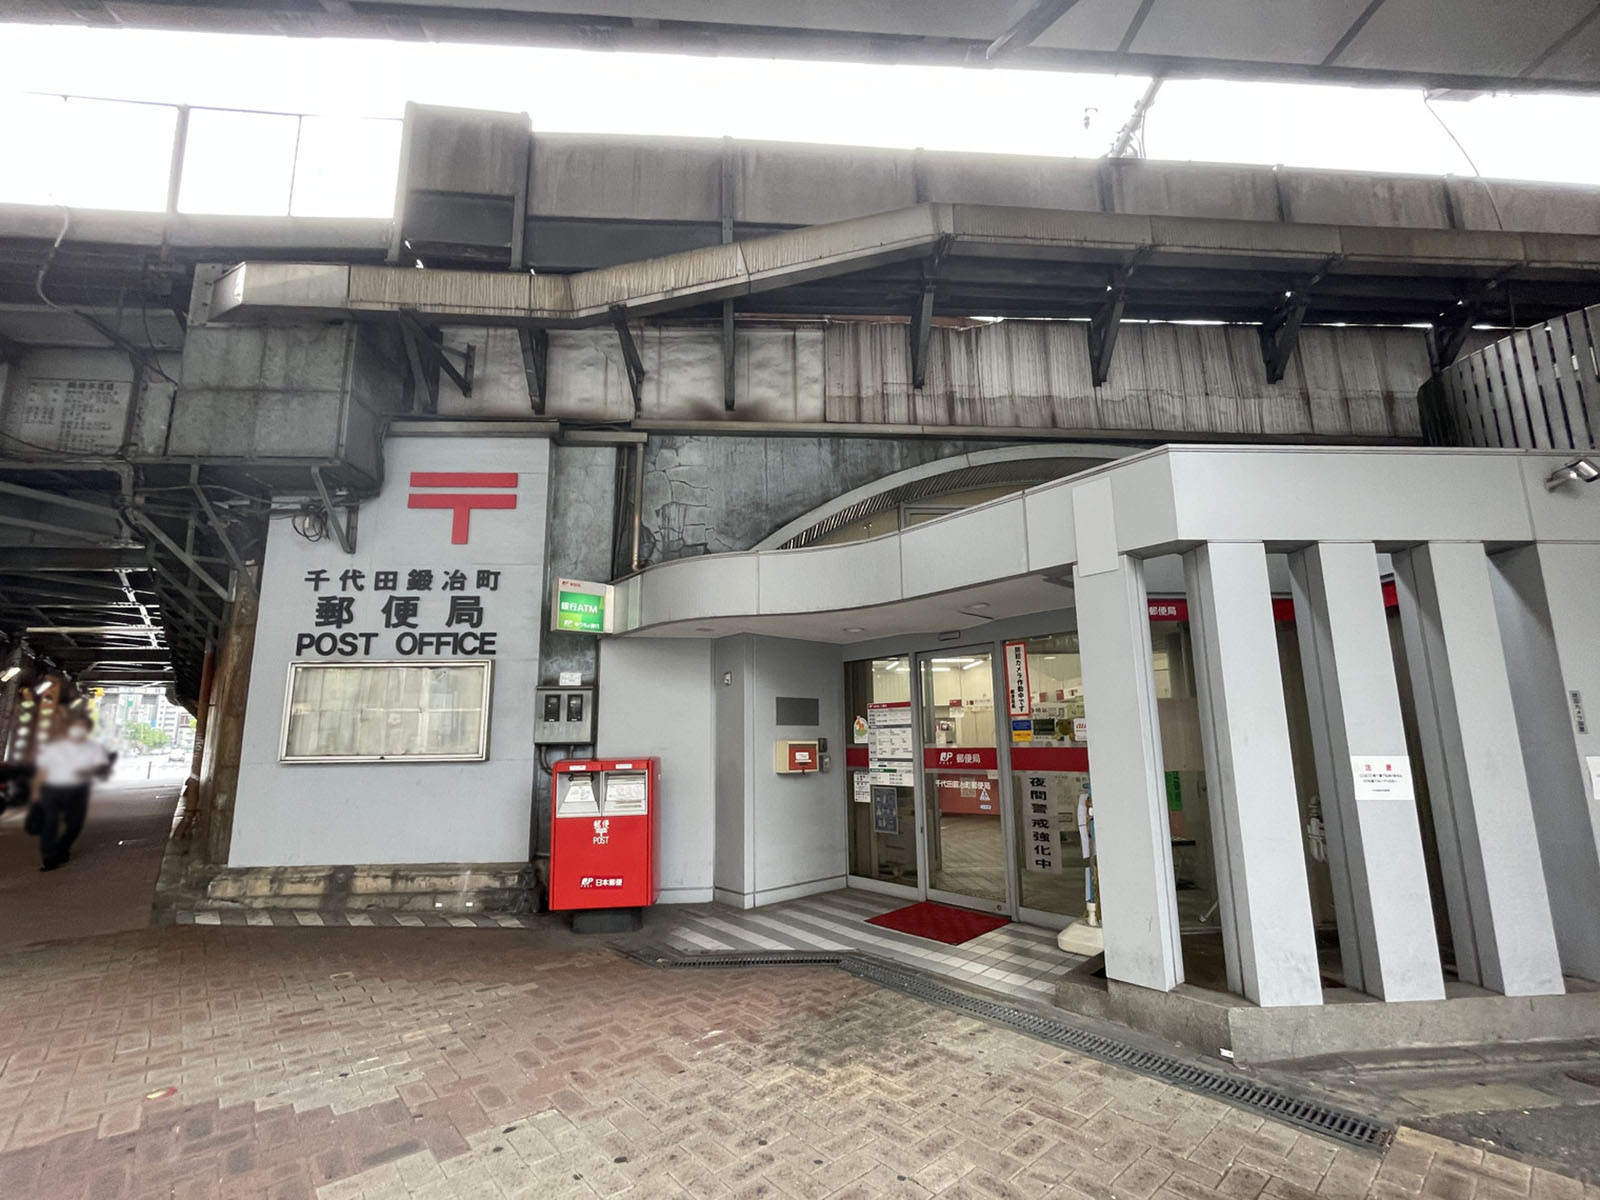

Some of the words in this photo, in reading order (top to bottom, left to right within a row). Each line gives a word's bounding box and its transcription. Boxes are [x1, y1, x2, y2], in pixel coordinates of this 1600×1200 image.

[303, 568, 502, 591] 千代田鍛冶町
[315, 595, 484, 629] 郵便局
[1149, 606, 1177, 616] 郵便局
[296, 632, 378, 656] POST
[395, 632, 497, 655] OFFICE
[956, 753, 981, 764] 郵便局
[1028, 777, 1052, 869] 夜間警戒強化中
[592, 836, 609, 845] POST
[595, 879, 623, 887] 日本郵便
